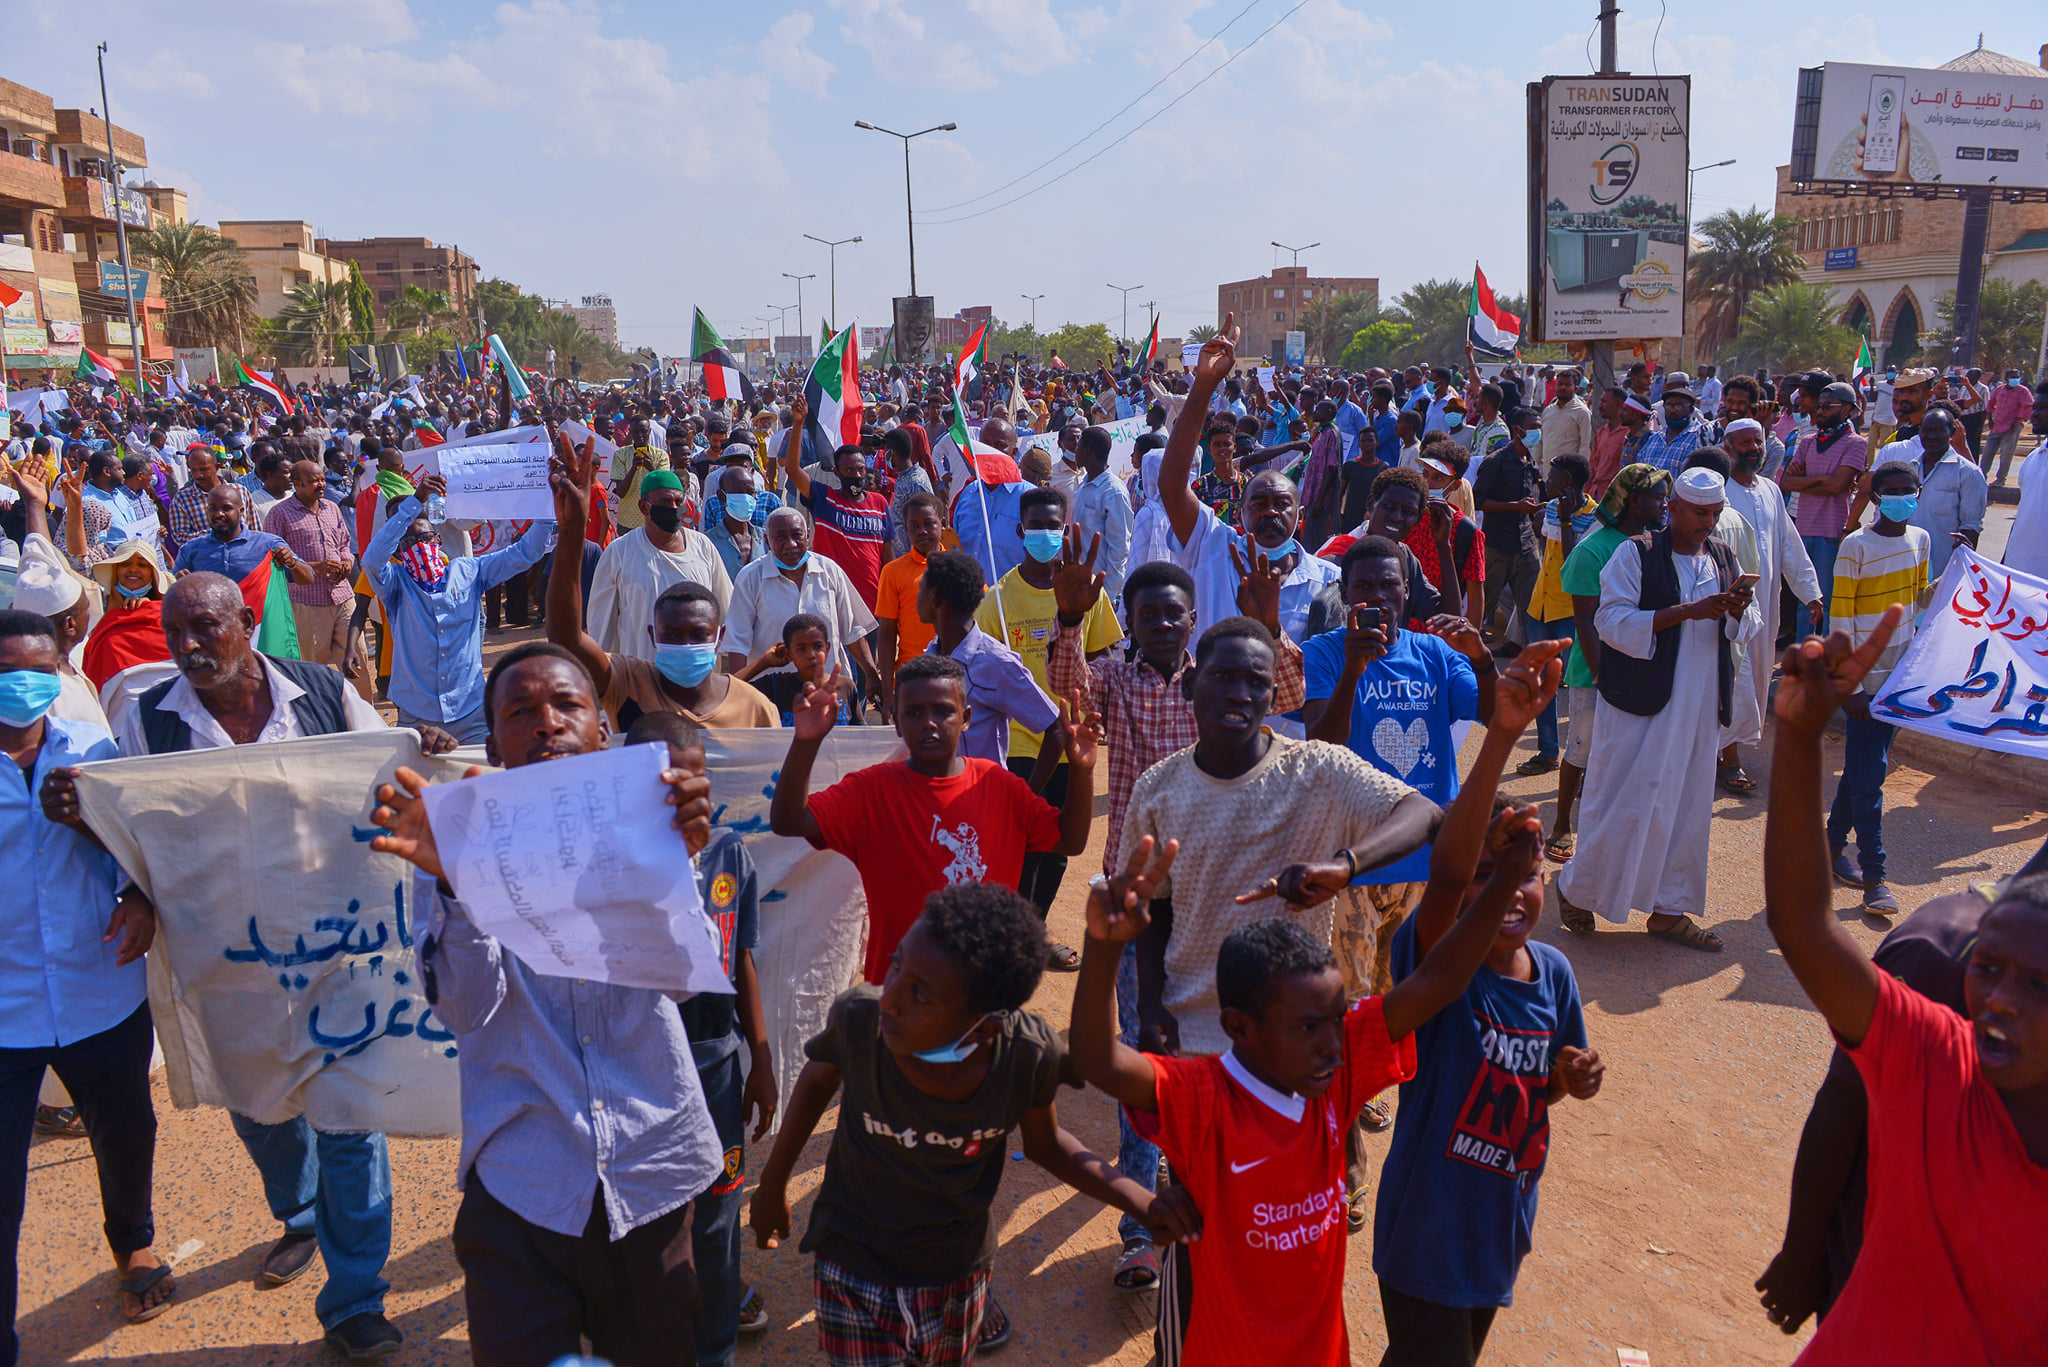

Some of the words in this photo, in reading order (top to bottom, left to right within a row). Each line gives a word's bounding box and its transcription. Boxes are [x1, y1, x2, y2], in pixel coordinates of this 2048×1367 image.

[1566, 87, 1669, 102] TRANSUDAN
[1951, 90, 2002, 110] تطبيق
[1559, 106, 1630, 115] TRANSFORMER
[1633, 105, 1676, 115] FACTORY
[1363, 680, 1437, 704] AUTISM
[1377, 702, 1429, 711] AWARENESS
[1453, 1134, 1506, 1167] MADE
